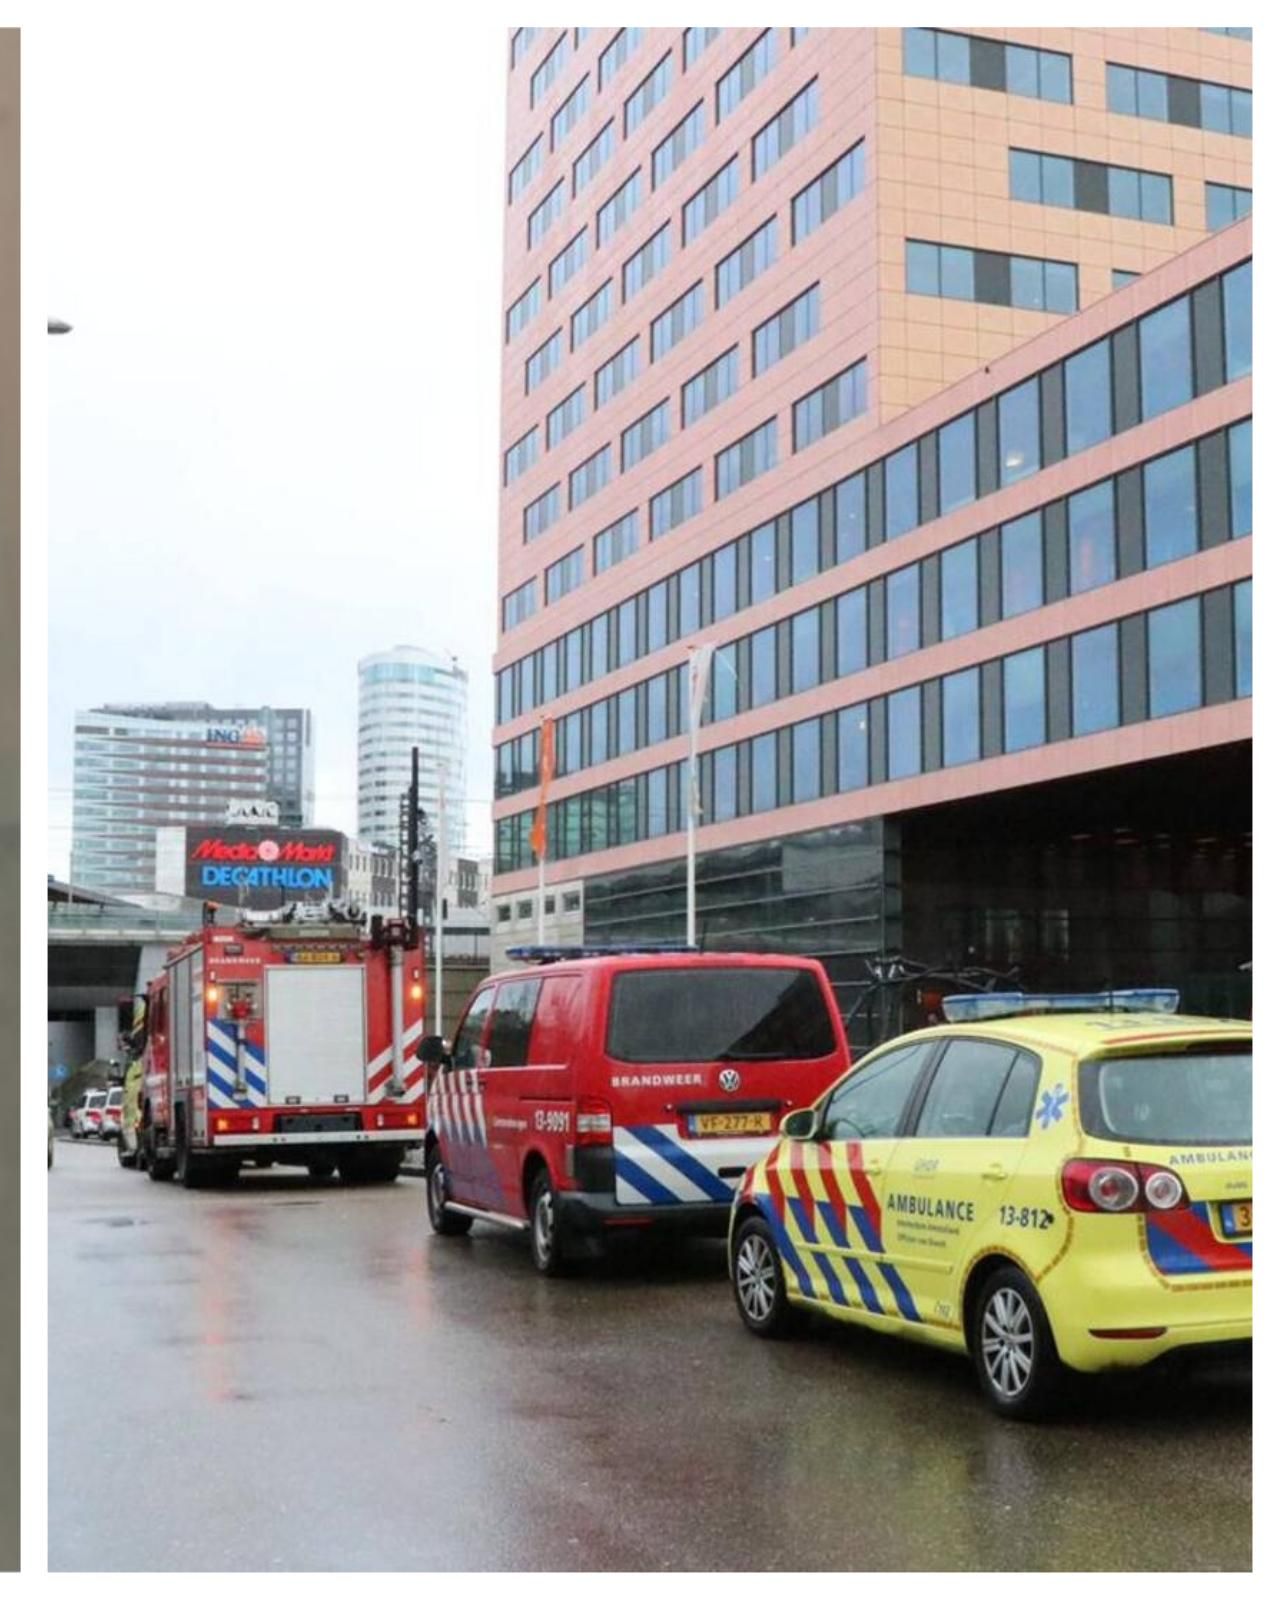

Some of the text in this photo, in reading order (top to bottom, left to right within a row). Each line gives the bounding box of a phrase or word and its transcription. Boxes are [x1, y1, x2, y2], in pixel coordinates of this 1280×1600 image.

[207, 728, 240, 743] ING
[202, 865, 333, 888] DECATHLON
[611, 1073, 703, 1088] BRANDWEER
[534, 1109, 570, 1132] 13-9091
[1169, 1150, 1252, 1165] AMBULAN
[887, 1193, 975, 1222] AMBULANCE
[999, 1205, 1051, 1230] 13-812
